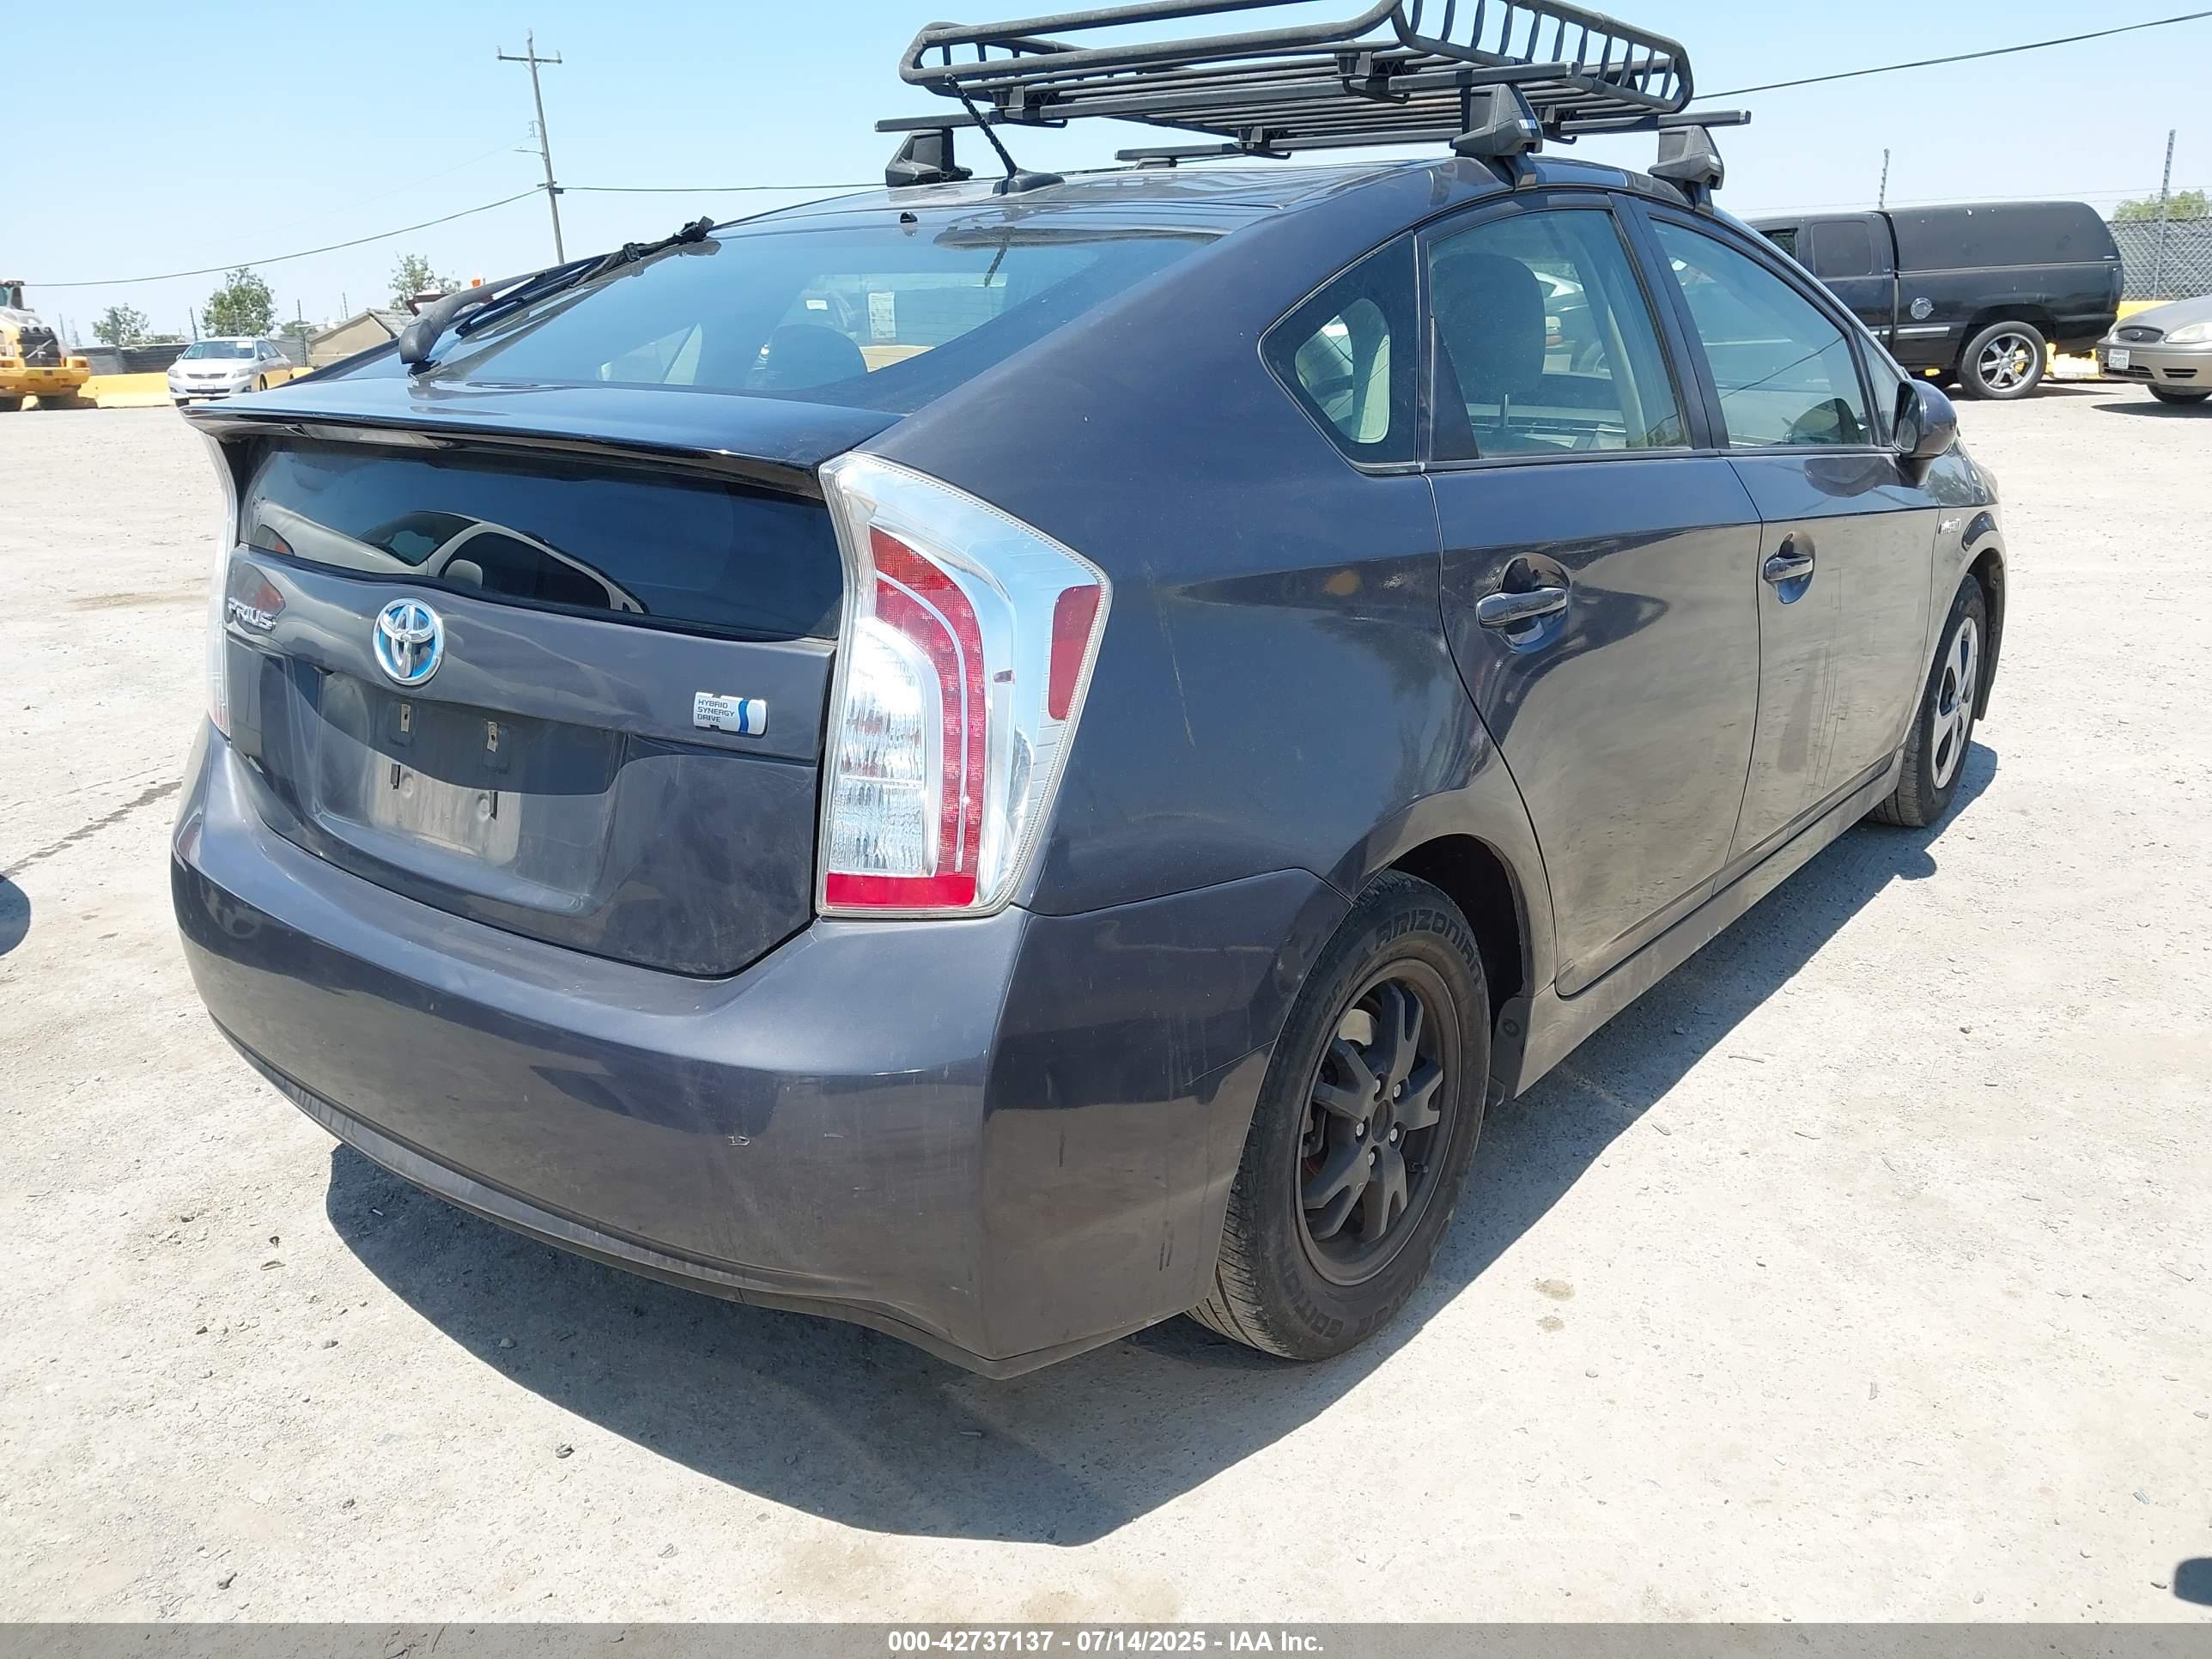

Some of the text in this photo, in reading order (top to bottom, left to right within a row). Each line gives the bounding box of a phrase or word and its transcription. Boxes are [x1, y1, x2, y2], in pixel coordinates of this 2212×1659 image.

[228, 597, 276, 629] PRIUS
[698, 699, 728, 709] HYBRID
[697, 707, 735, 717] SYNERGY
[697, 714, 721, 723] DRIVE
